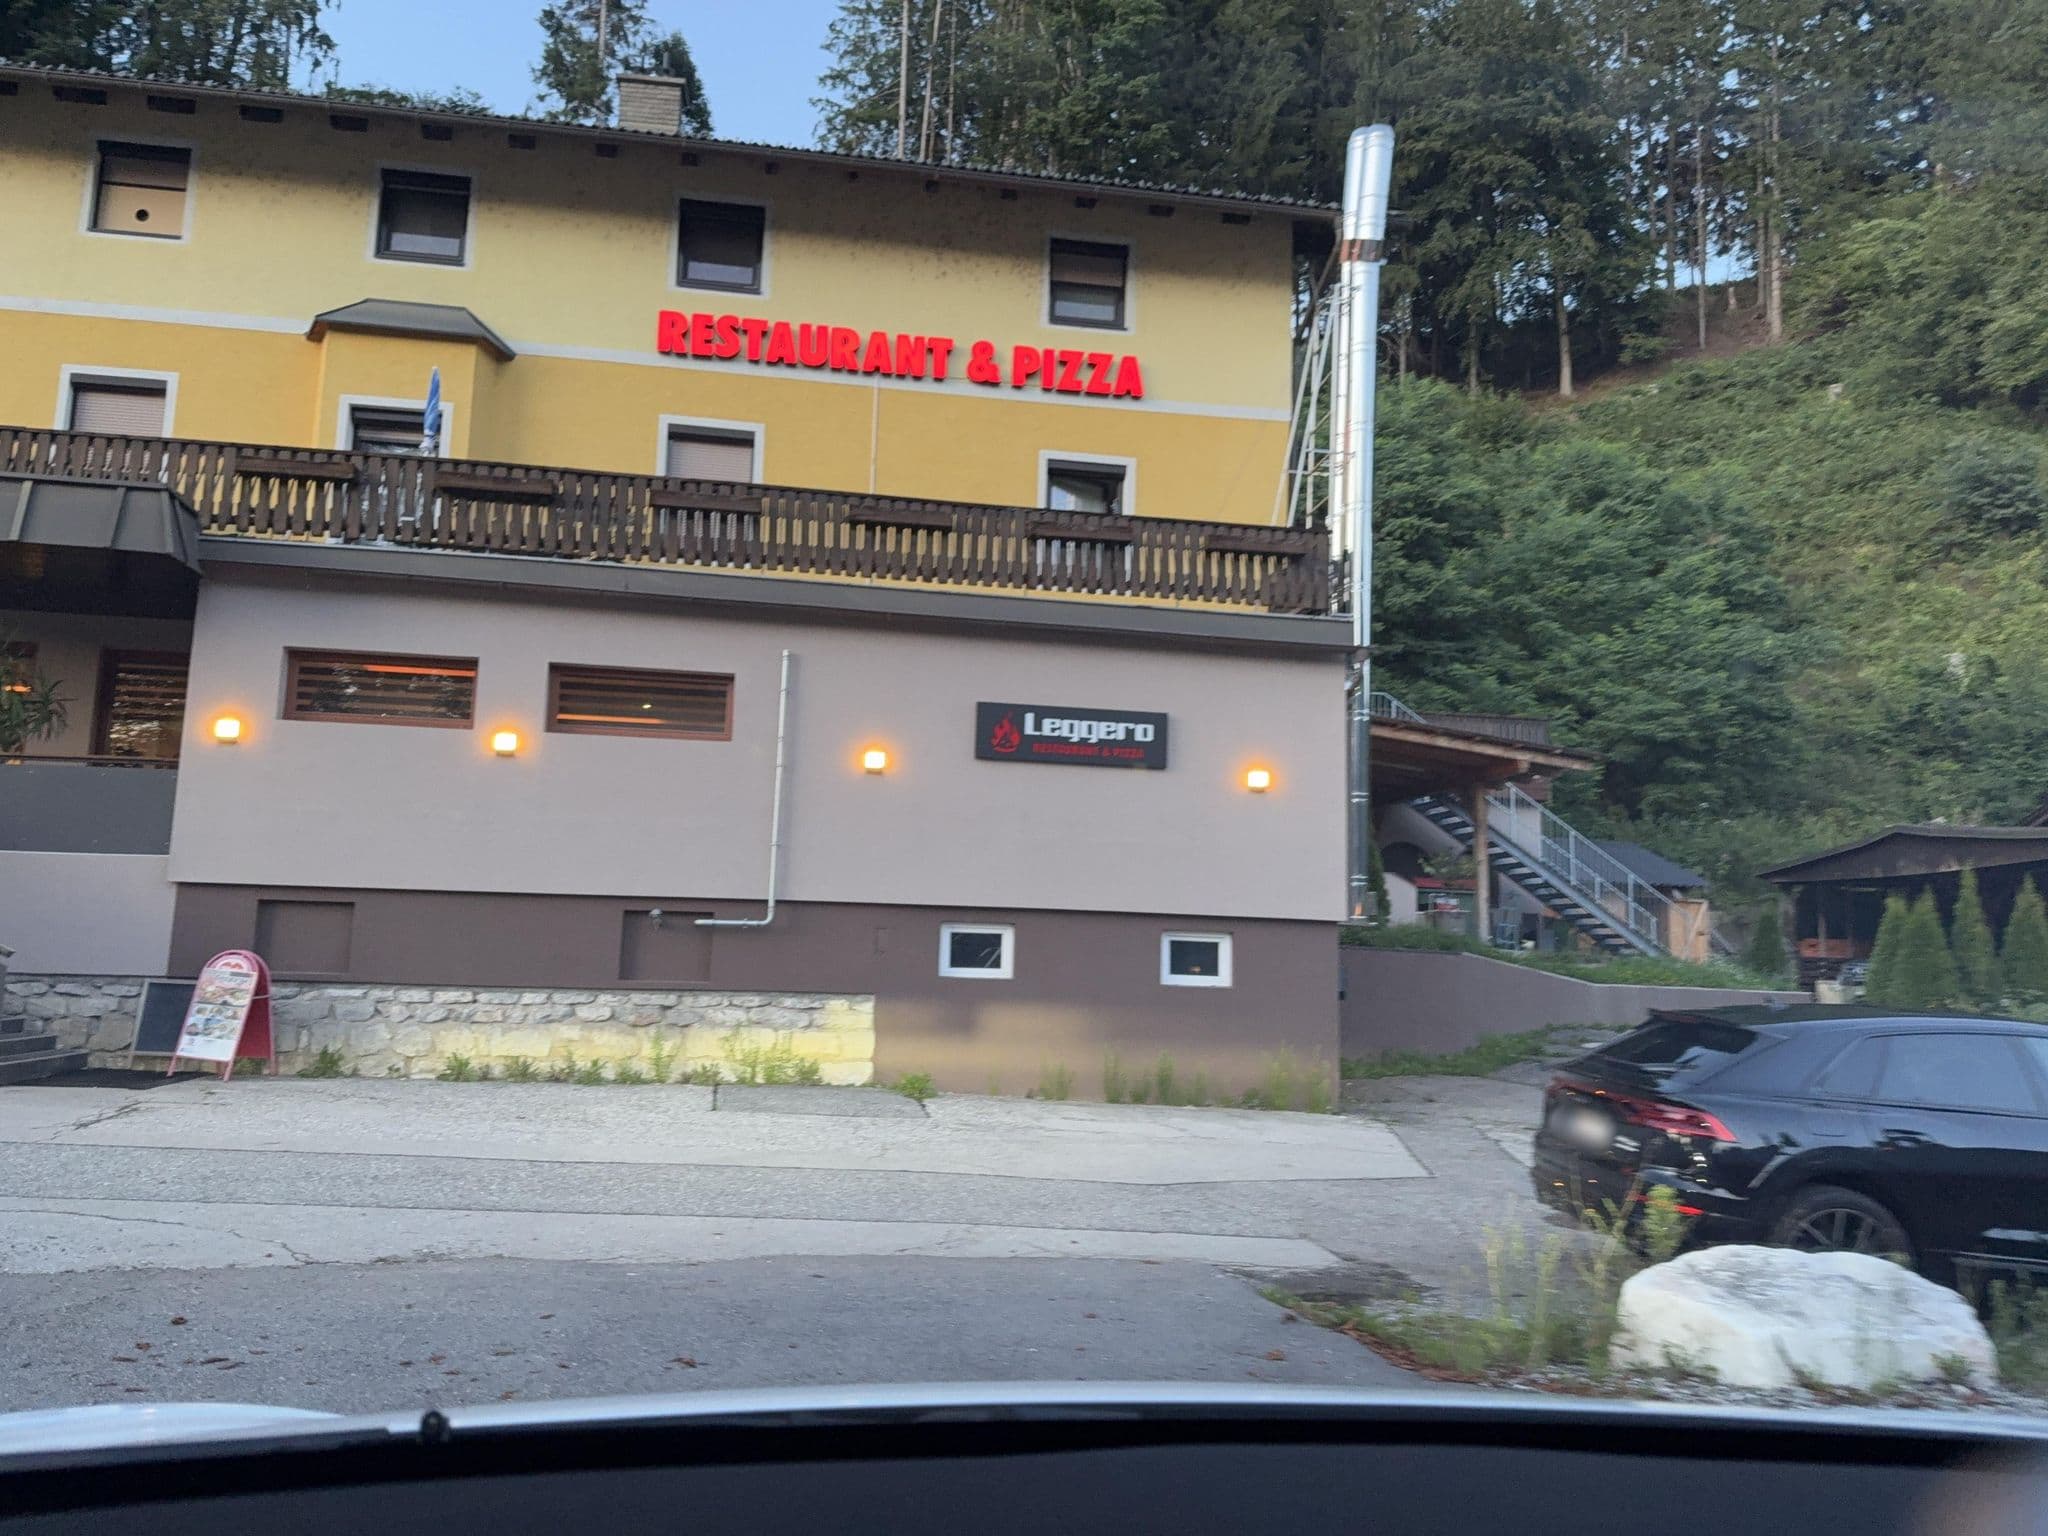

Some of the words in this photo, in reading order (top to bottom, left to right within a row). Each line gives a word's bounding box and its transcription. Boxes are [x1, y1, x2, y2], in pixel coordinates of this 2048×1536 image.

[657, 310, 954, 379] RESTAURANT
[966, 340, 1001, 384] &
[1011, 345, 1144, 398] PIZZA
[1024, 712, 1155, 743] Leggero
